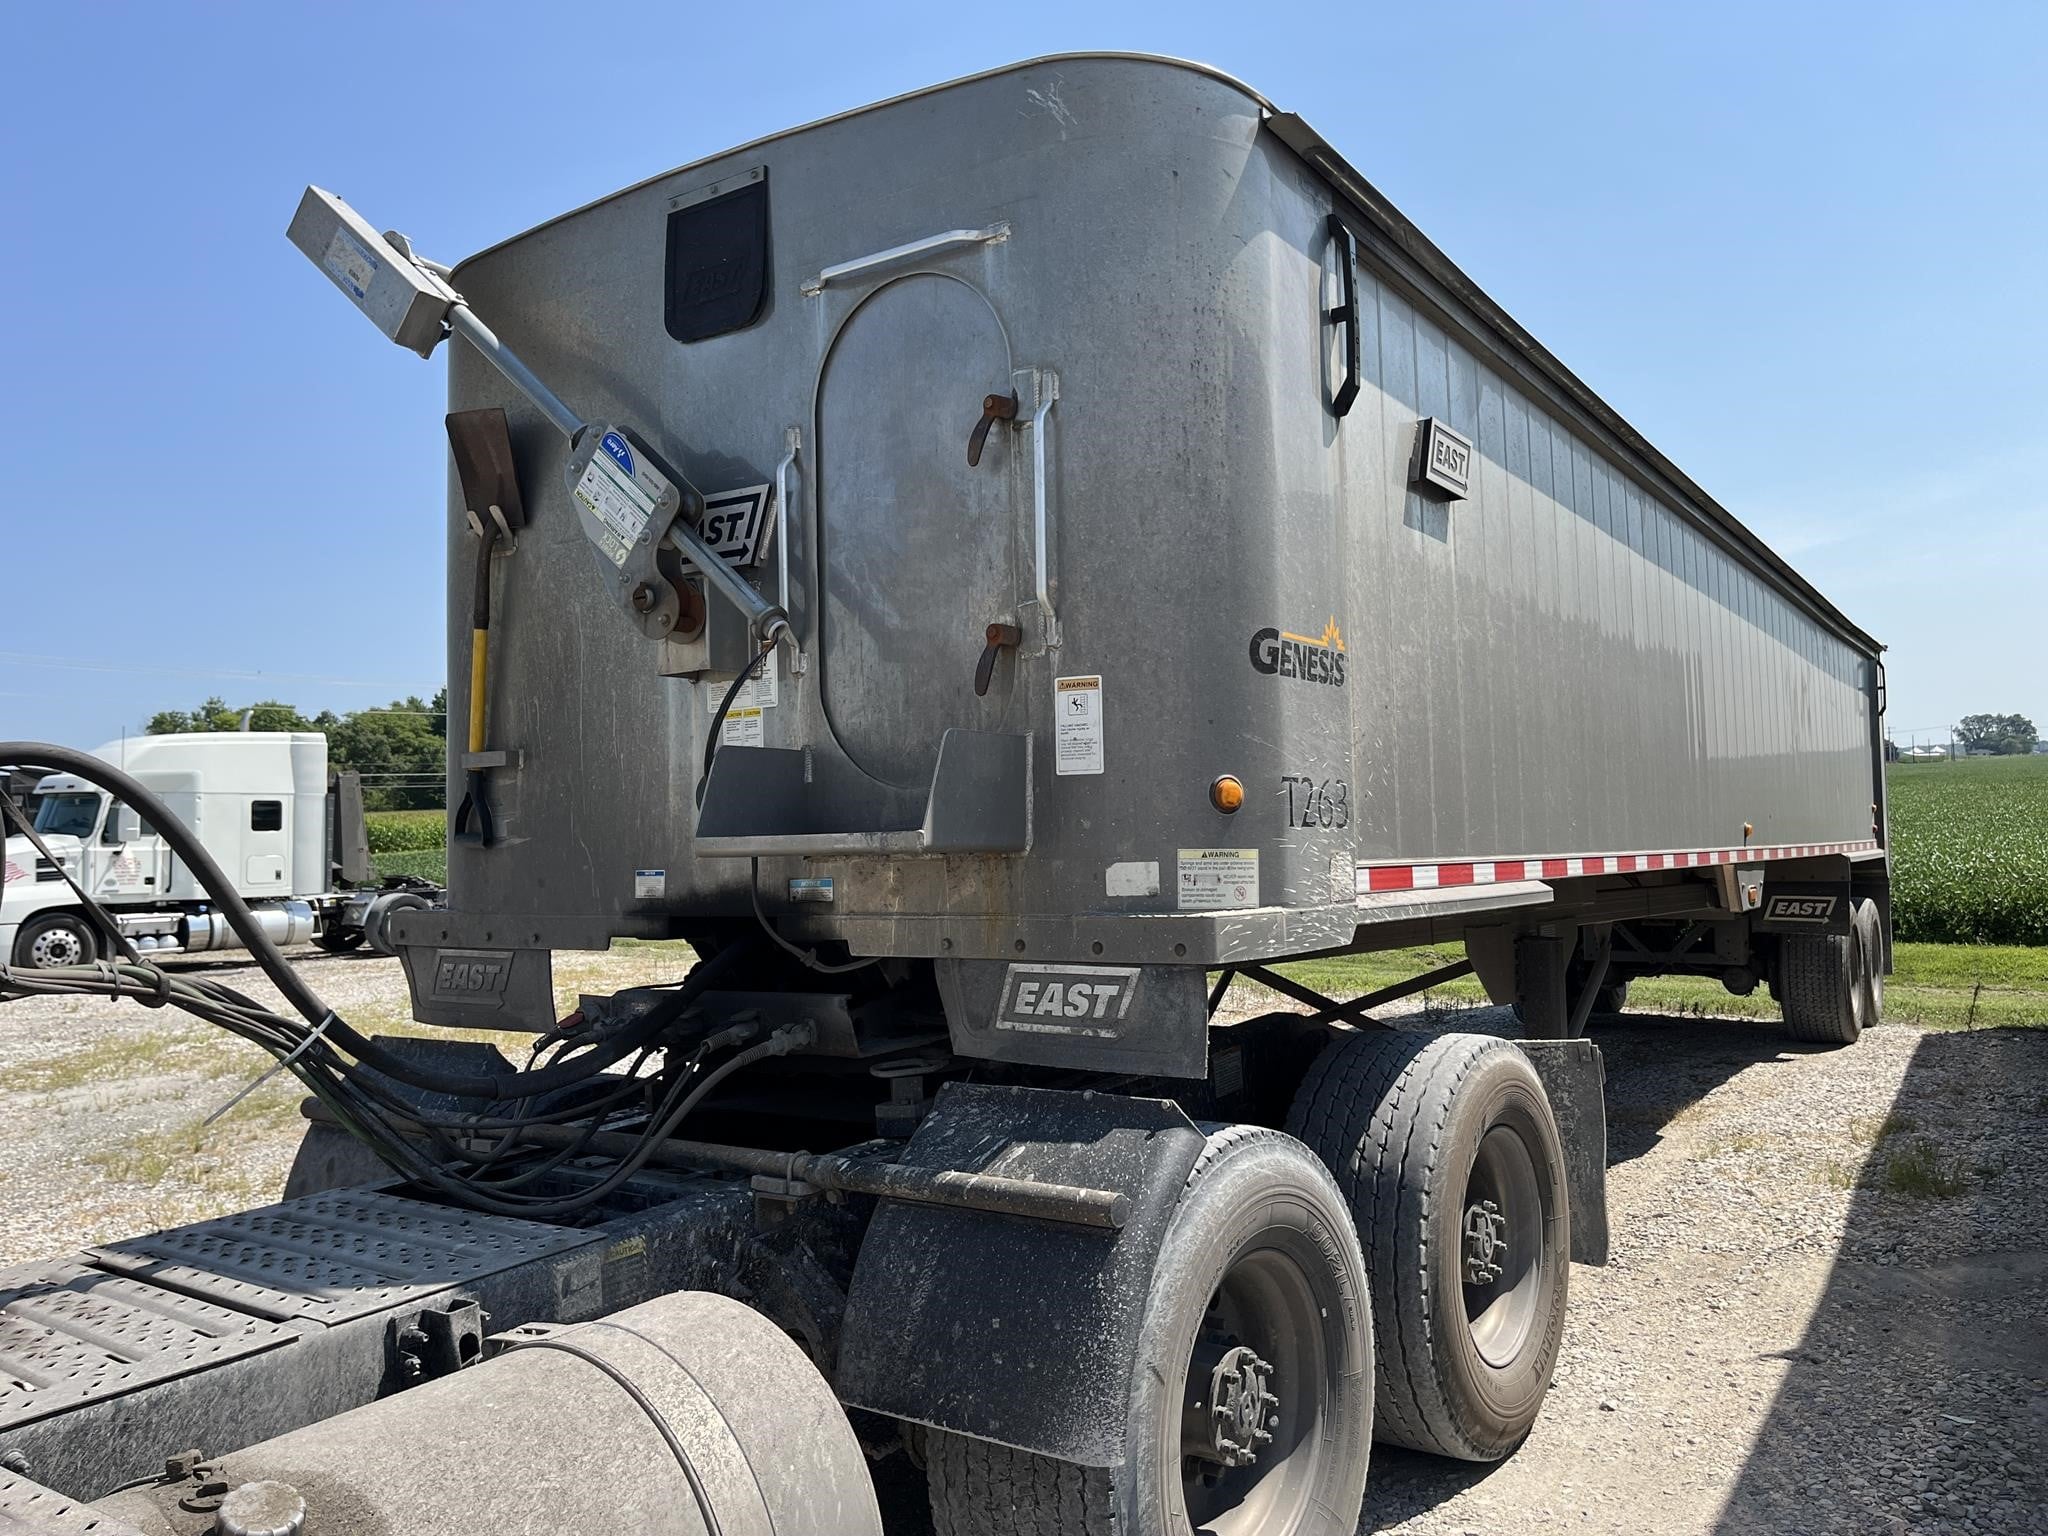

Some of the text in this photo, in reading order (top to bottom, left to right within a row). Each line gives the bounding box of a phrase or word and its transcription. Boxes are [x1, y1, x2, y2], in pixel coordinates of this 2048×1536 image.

[1436, 439, 1465, 476] EAST
[575, 490, 594, 509] CAUTION
[1249, 627, 1345, 687] GENESIS
[1065, 680, 1098, 689] WARNING
[1281, 776, 1348, 828] T263
[1775, 901, 1827, 916] EAST
[440, 963, 501, 992] EAST
[1014, 982, 1120, 1019] EAST
